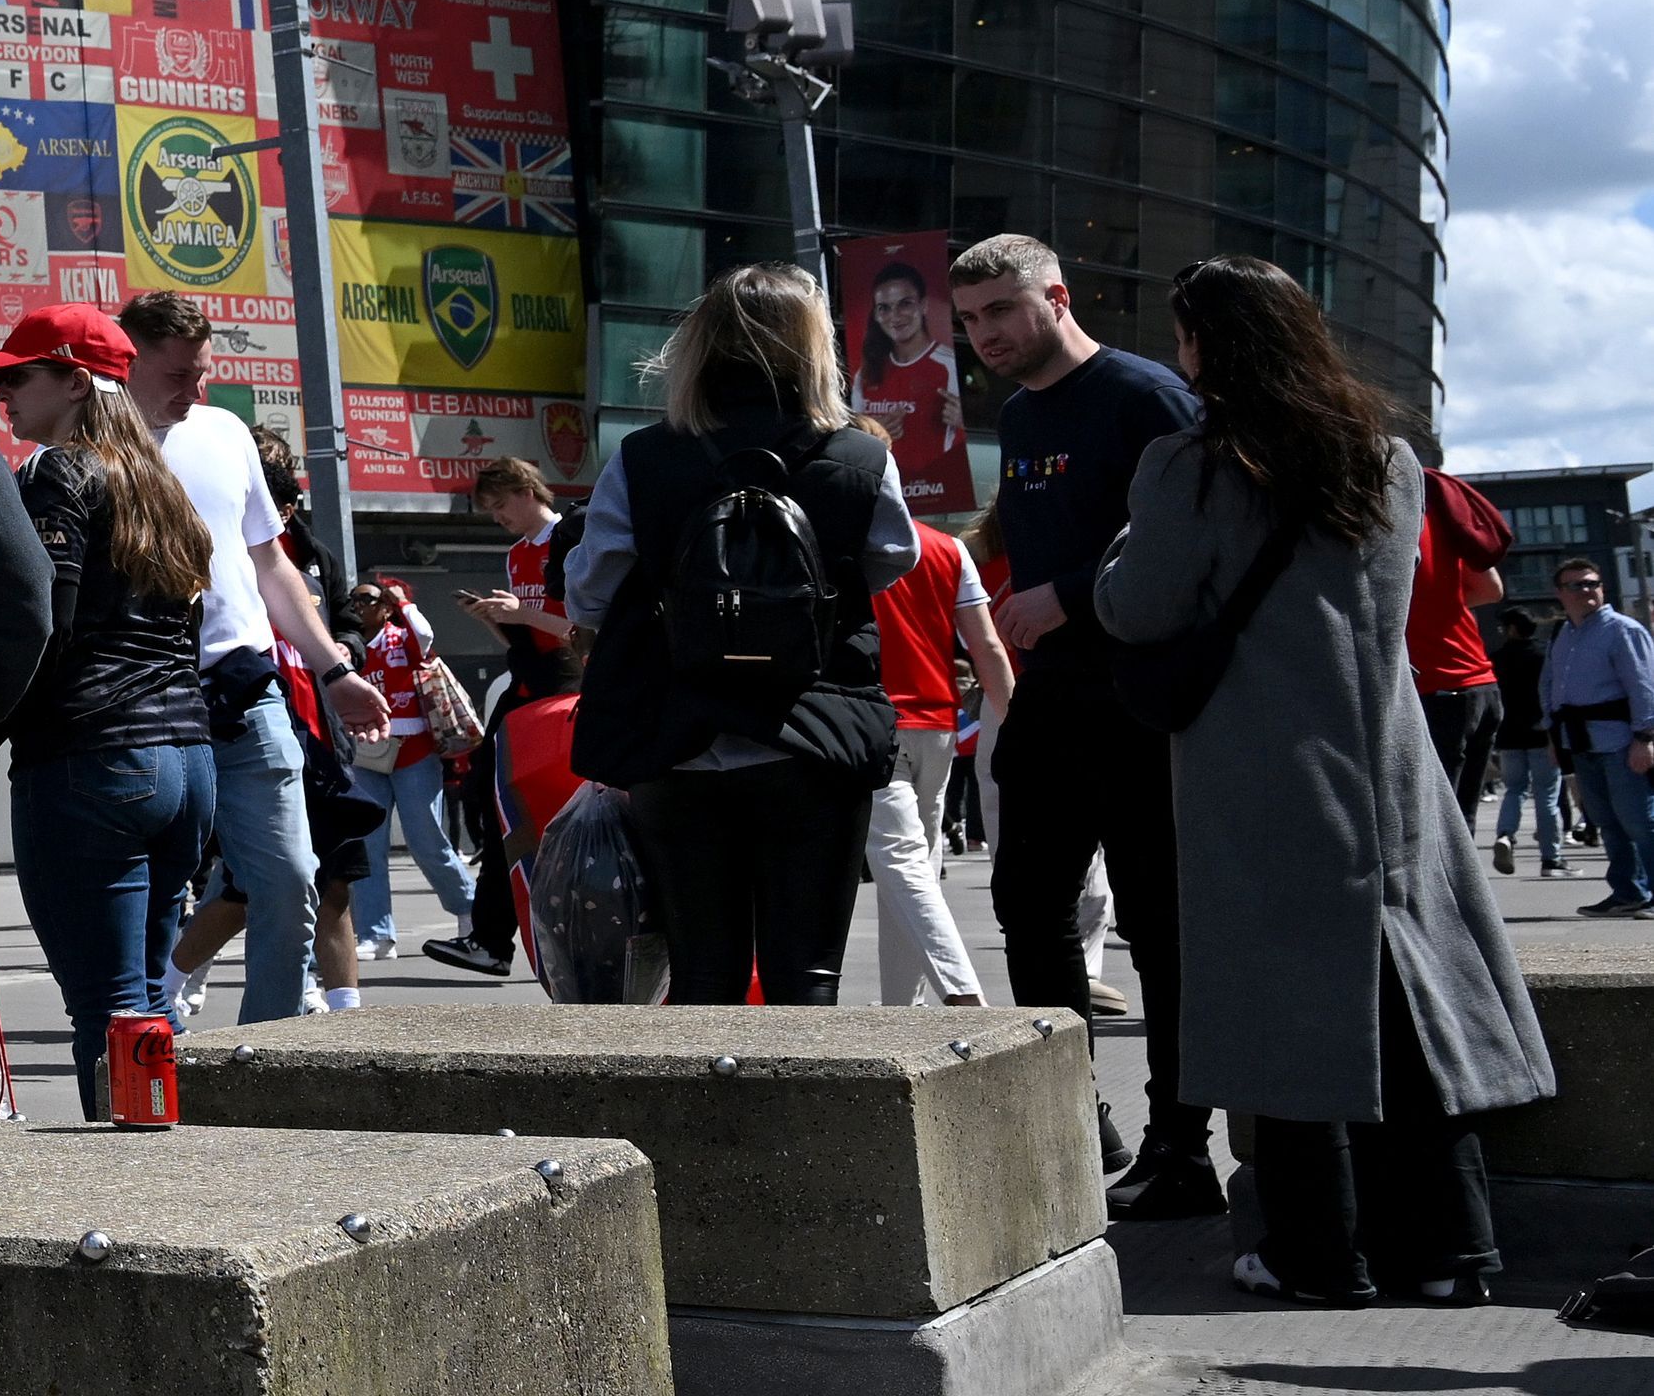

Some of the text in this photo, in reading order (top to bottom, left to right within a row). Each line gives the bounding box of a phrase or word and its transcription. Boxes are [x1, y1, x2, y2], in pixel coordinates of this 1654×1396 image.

[120, 74, 245, 113] GUNNERS
[36, 135, 111, 160] ARSENAL
[151, 223, 239, 249] JAMAICA
